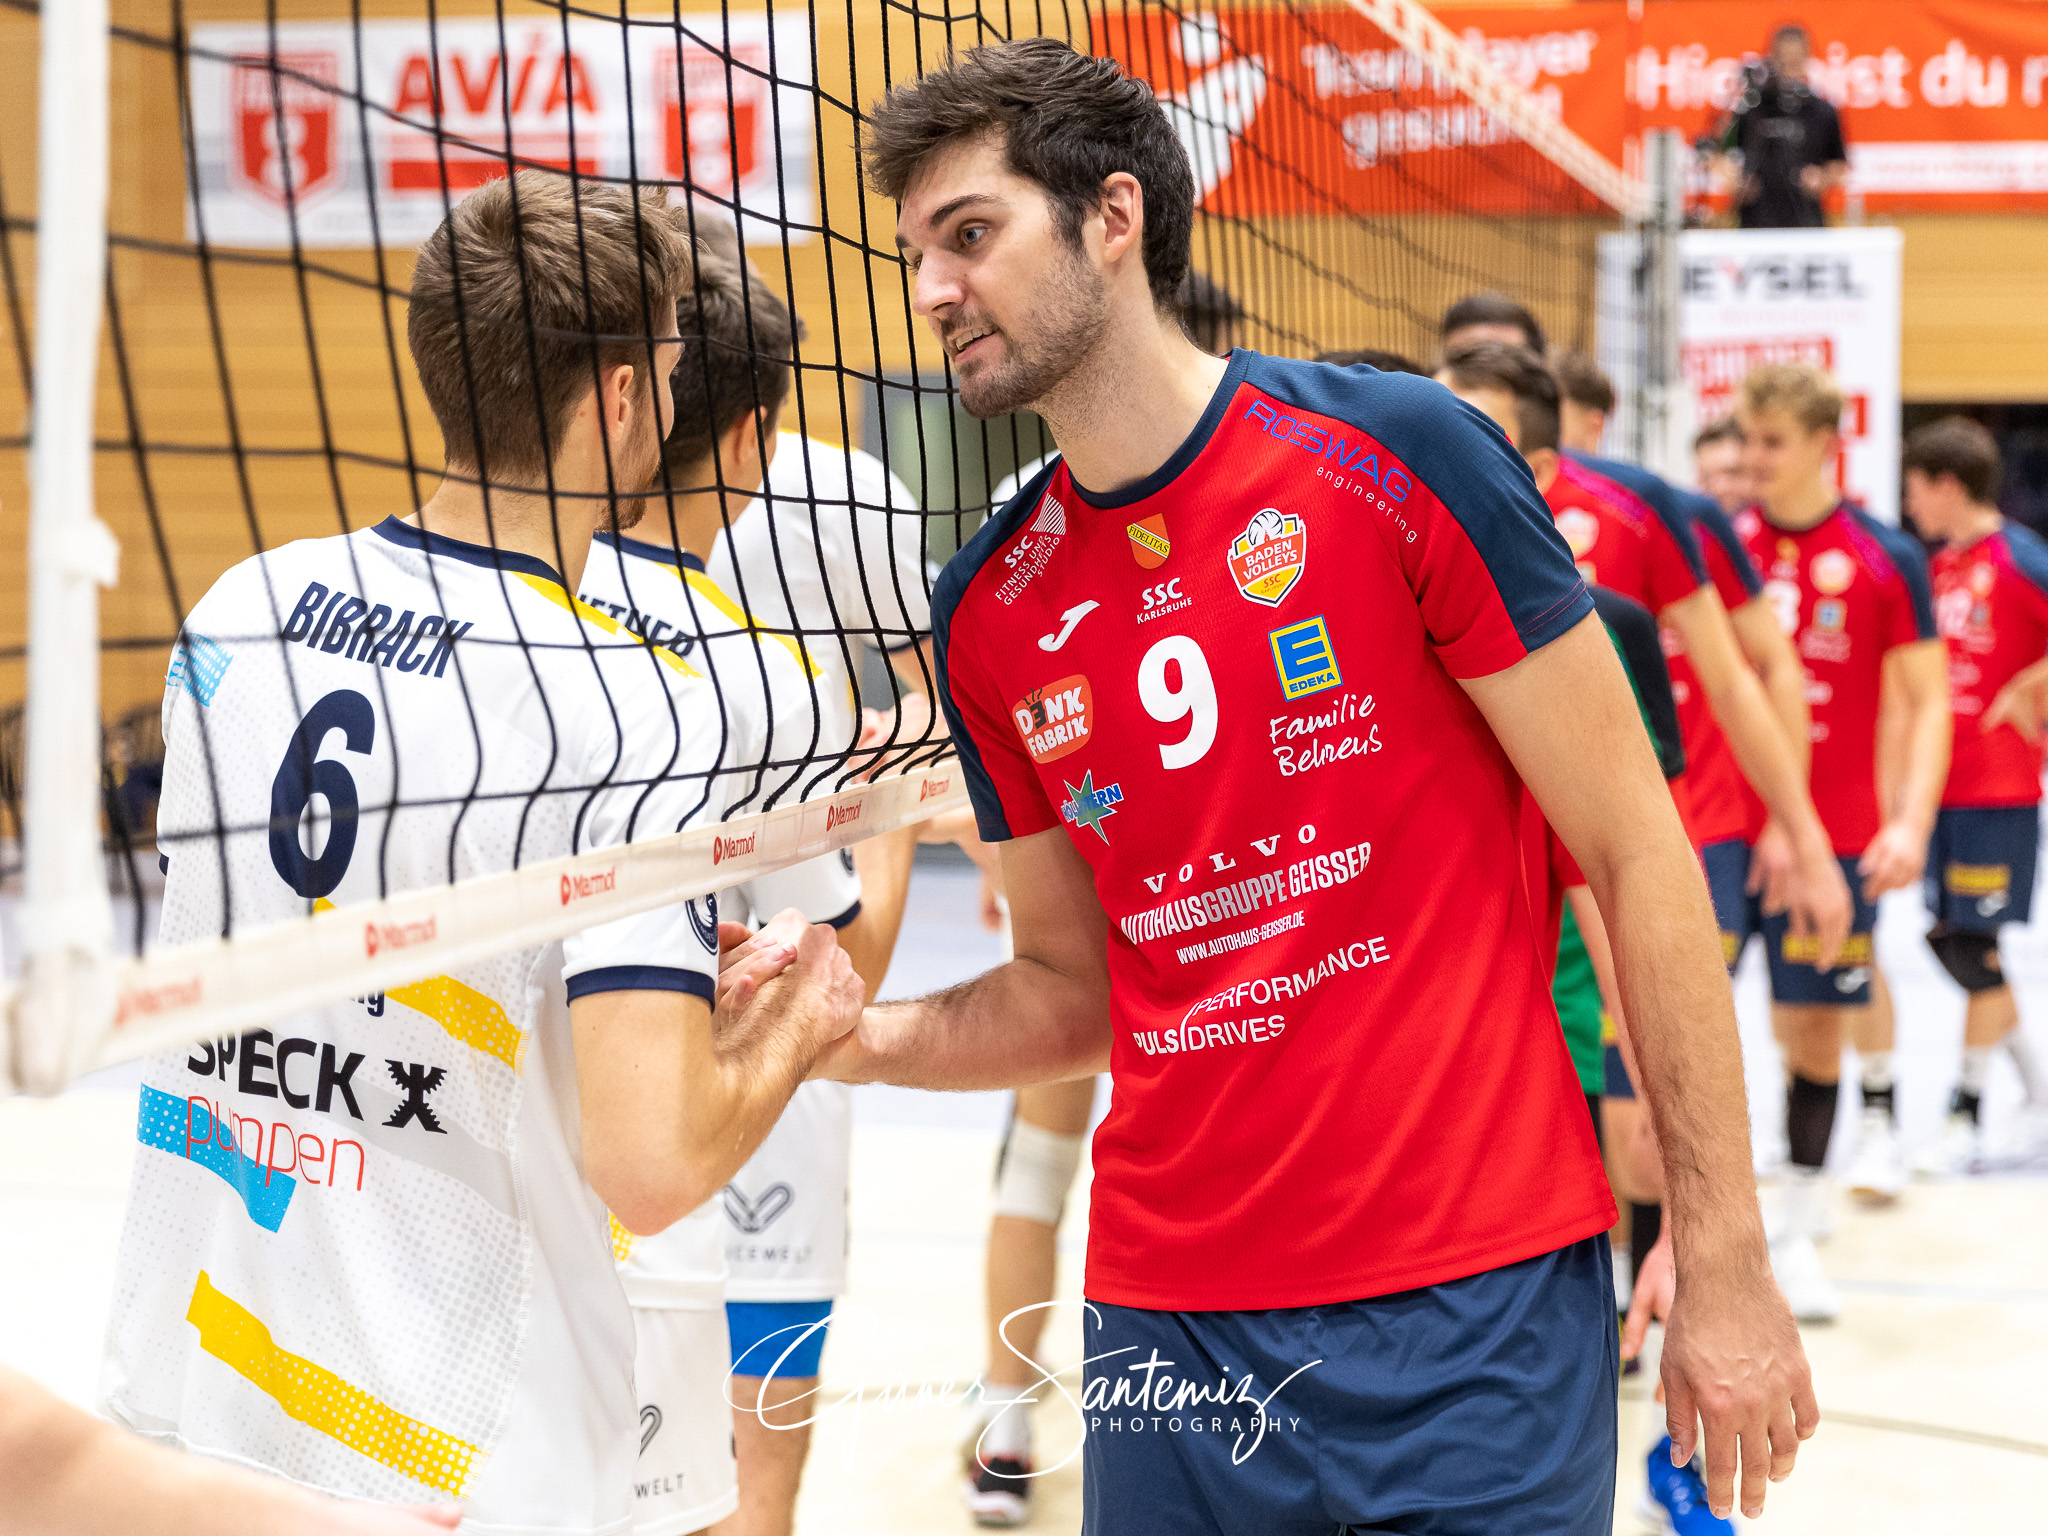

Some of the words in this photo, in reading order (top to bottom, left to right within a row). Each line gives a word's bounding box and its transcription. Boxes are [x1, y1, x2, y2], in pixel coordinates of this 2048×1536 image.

[1920, 38, 2009, 107] du
[1244, 399, 1412, 502] ROSSWAG
[1316, 466, 1418, 543] engineering
[1004, 535, 1033, 568] SSC
[1037, 537, 1060, 577] STUDIO
[1128, 525, 1169, 553] FIDELITAS
[1245, 539, 1292, 568] BADEN
[995, 560, 1030, 600] FITNESS
[1242, 549, 1298, 580] VOLLEYS
[1263, 573, 1281, 588] SSC
[1136, 597, 1192, 624] KARLSRUHE
[1142, 577, 1183, 610] SSC
[281, 581, 475, 678] BIBRACK
[1137, 634, 1219, 770] 9
[1289, 672, 1336, 693] EDEKA
[1027, 715, 1088, 757] FABRIK
[1269, 693, 1376, 744] Familie
[1272, 724, 1382, 776] Behrens
[268, 689, 376, 899] 6
[834, 800, 863, 827] Marmot
[722, 831, 756, 860] Marmot
[1144, 824, 1316, 894] VOLVO
[572, 866, 615, 897] Marmot
[1288, 841, 1371, 898] GEISSER
[1176, 910, 1305, 964] WWW.AUTOHAUS-GEISSER.DE
[1193, 936, 1390, 1016] PERFORMANCE
[187, 1025, 366, 1121] SPECK
[185, 1096, 365, 1191] pumpen
